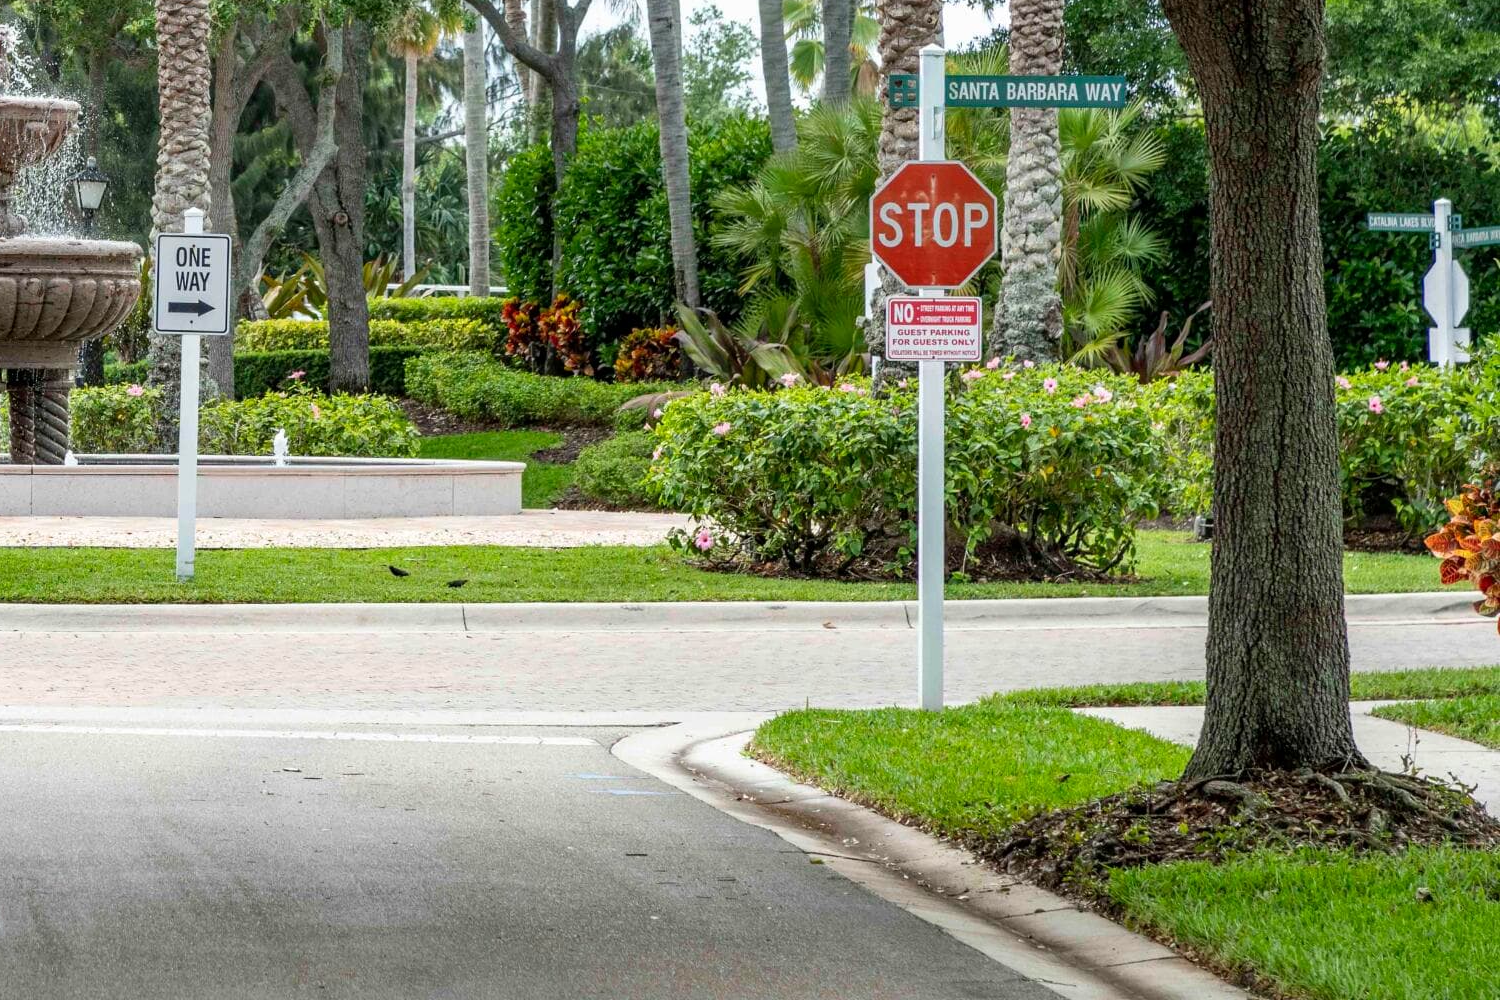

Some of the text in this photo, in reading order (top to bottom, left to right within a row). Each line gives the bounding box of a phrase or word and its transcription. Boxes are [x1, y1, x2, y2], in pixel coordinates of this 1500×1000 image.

[949, 82, 1122, 102] SANTA BARBARA WAY
[878, 202, 989, 248] STOP
[1399, 216, 1419, 228] LAKES
[176, 246, 211, 267] ONE
[176, 271, 210, 291] WAY
[893, 303, 914, 324] NO
